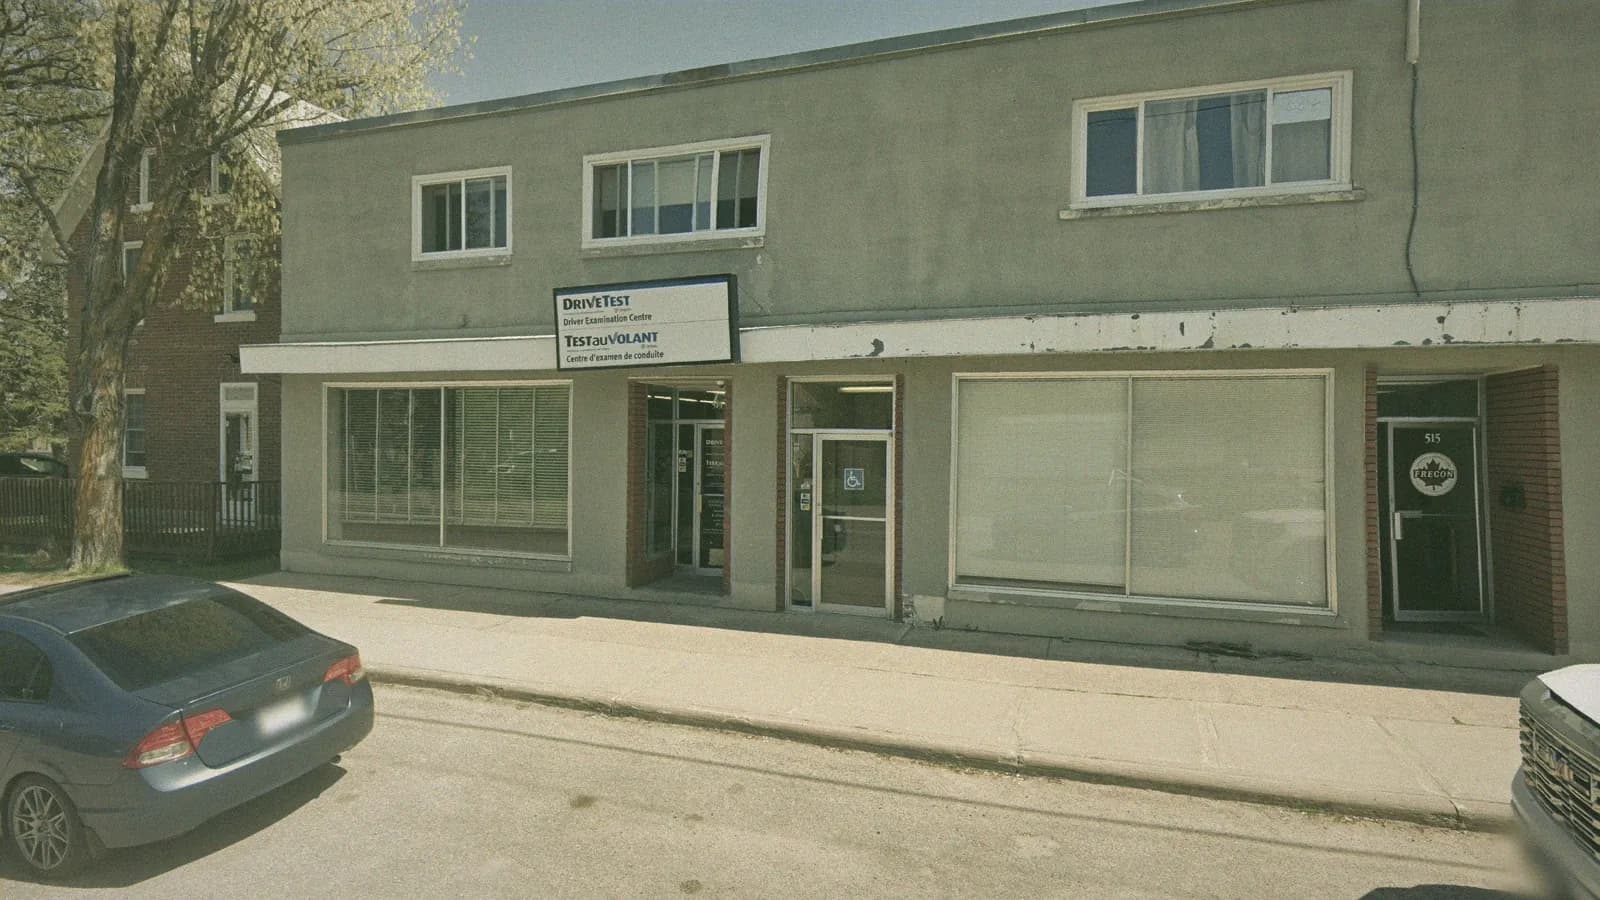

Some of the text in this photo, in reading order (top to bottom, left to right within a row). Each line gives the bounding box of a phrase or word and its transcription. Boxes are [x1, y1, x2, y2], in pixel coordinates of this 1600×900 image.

[563, 295, 630, 310] DRIVETEST
[563, 312, 652, 326] Driver Examination Centre
[566, 350, 664, 363] Centre d'examen de conduite
[1425, 433, 1440, 444] 515
[1414, 470, 1454, 478] FRECON
